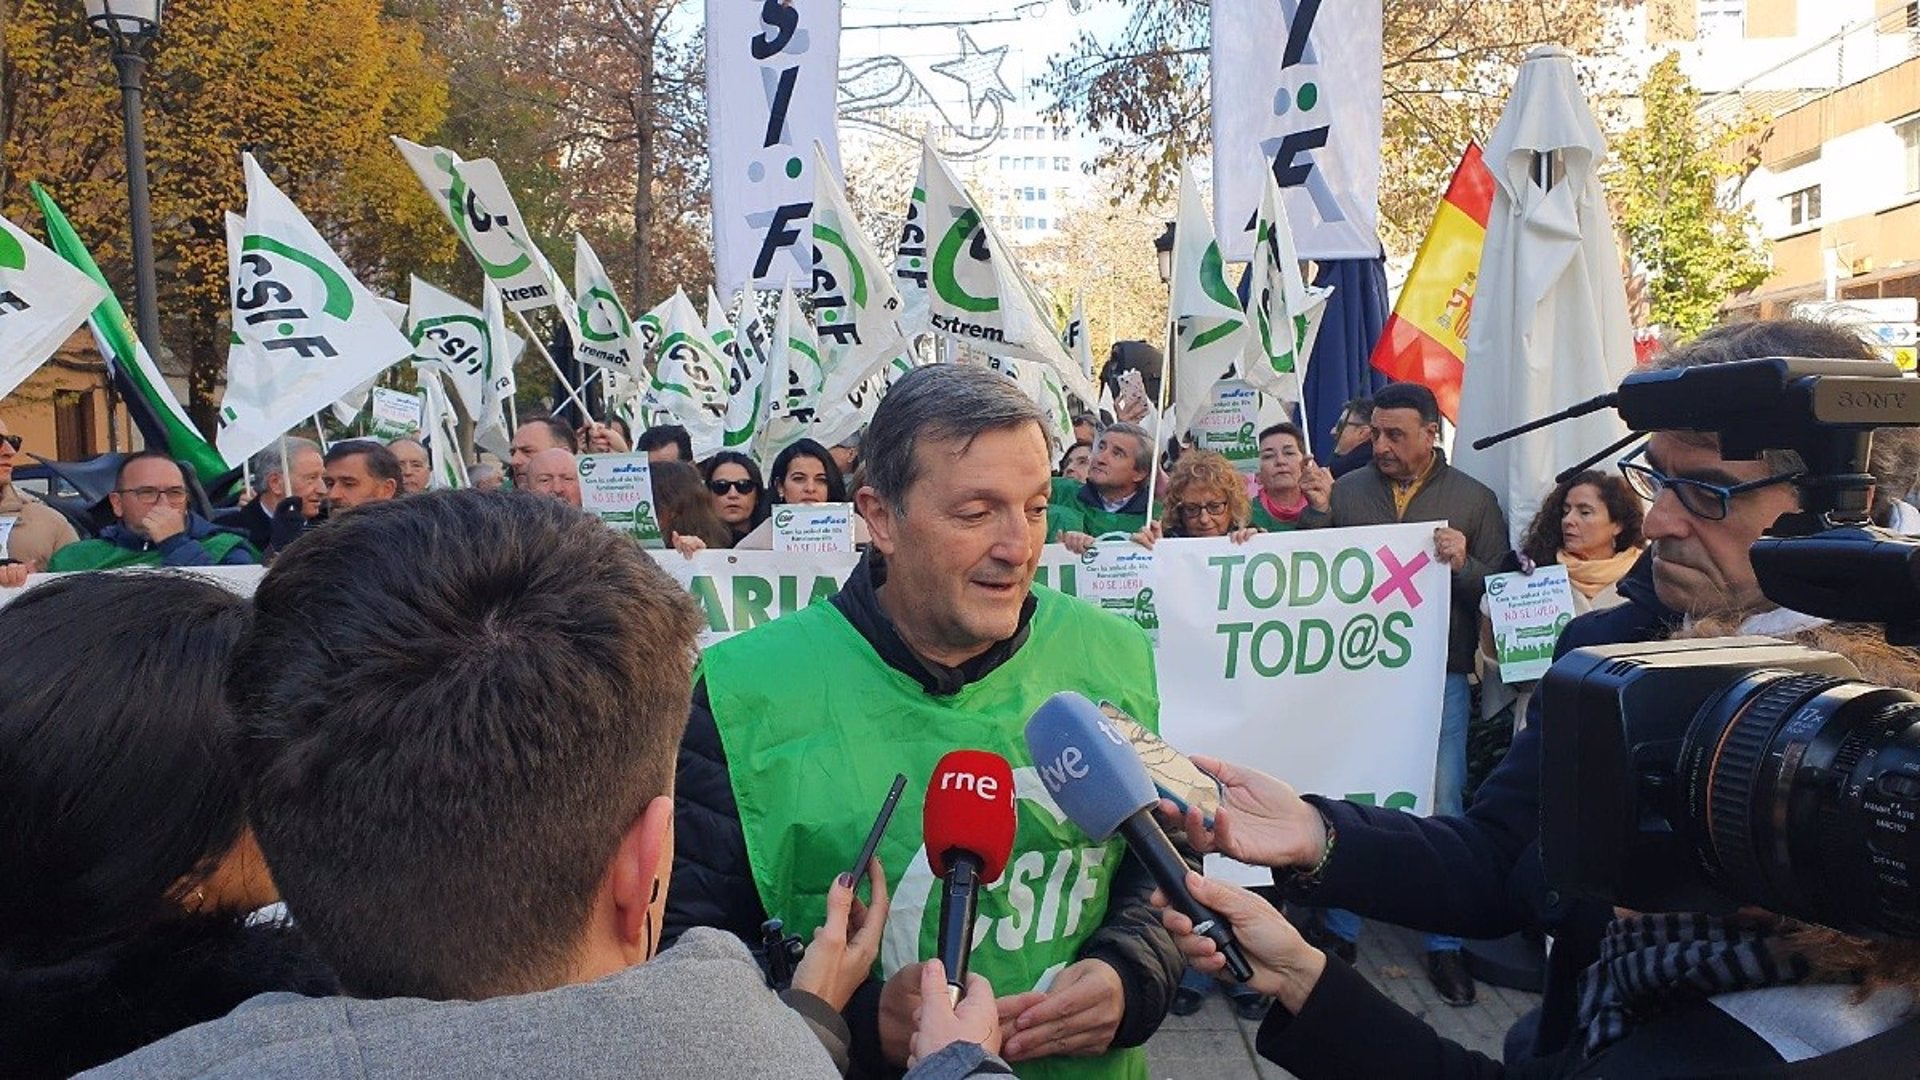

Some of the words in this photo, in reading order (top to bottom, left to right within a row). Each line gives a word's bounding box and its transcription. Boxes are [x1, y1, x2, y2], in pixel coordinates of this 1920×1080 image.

[1208, 547, 1375, 611] TODO
[1216, 611, 1414, 679] TOD@S
[940, 770, 998, 800] rne
[1040, 746, 1090, 793] tve
